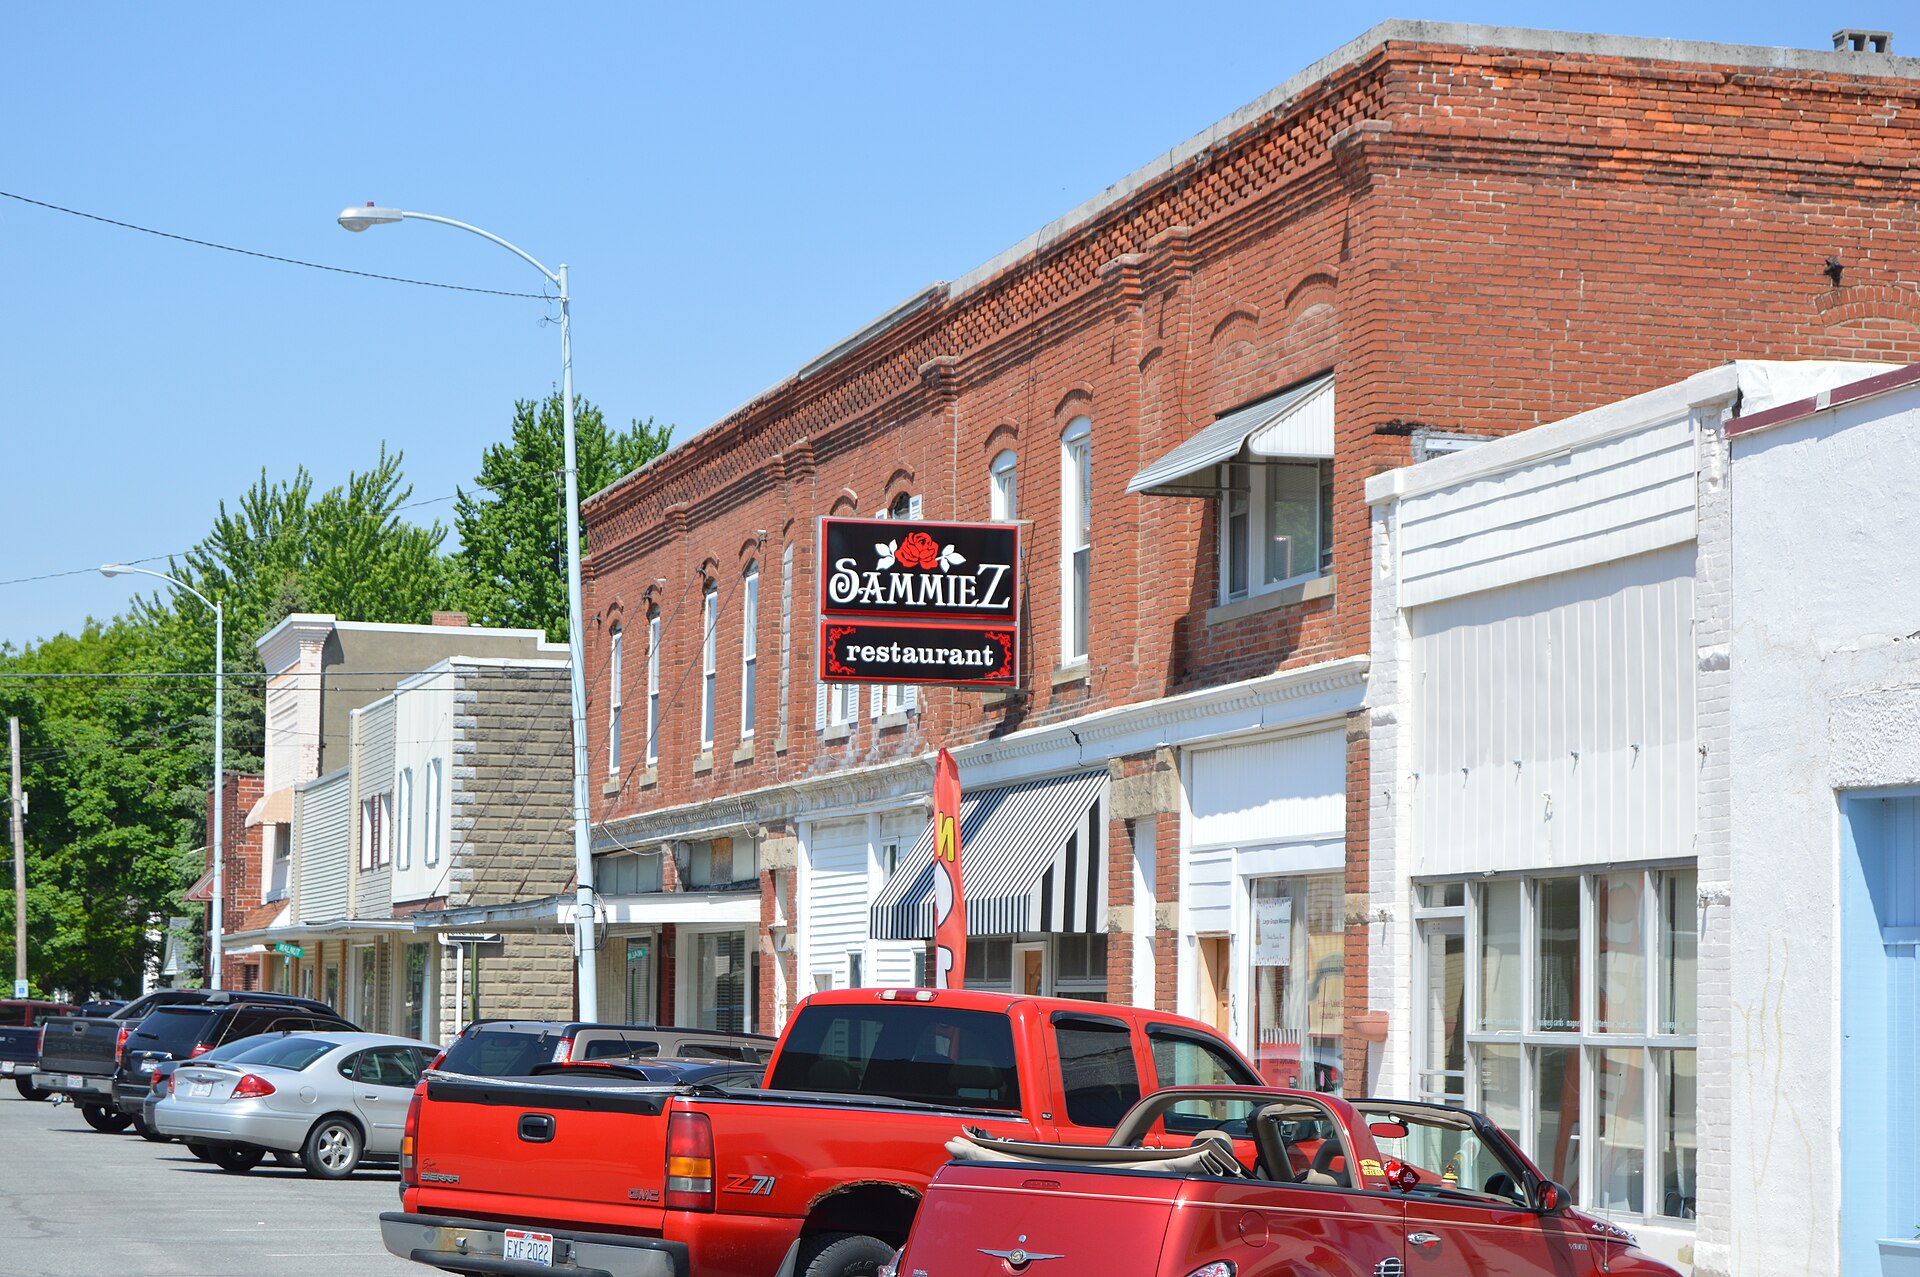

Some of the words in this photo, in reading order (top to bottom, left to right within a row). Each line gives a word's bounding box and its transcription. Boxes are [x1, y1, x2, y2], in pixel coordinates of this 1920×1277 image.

[829, 558, 1011, 609] SAMMIEZ
[846, 641, 994, 667] restaurant
[278, 943, 302, 957] WALNUT
[421, 1172, 460, 1183] SIERRA
[722, 1174, 775, 1196] Z71
[628, 1188, 659, 1202] GMC
[507, 1239, 524, 1258] EXF
[527, 1242, 549, 1263] 2022
